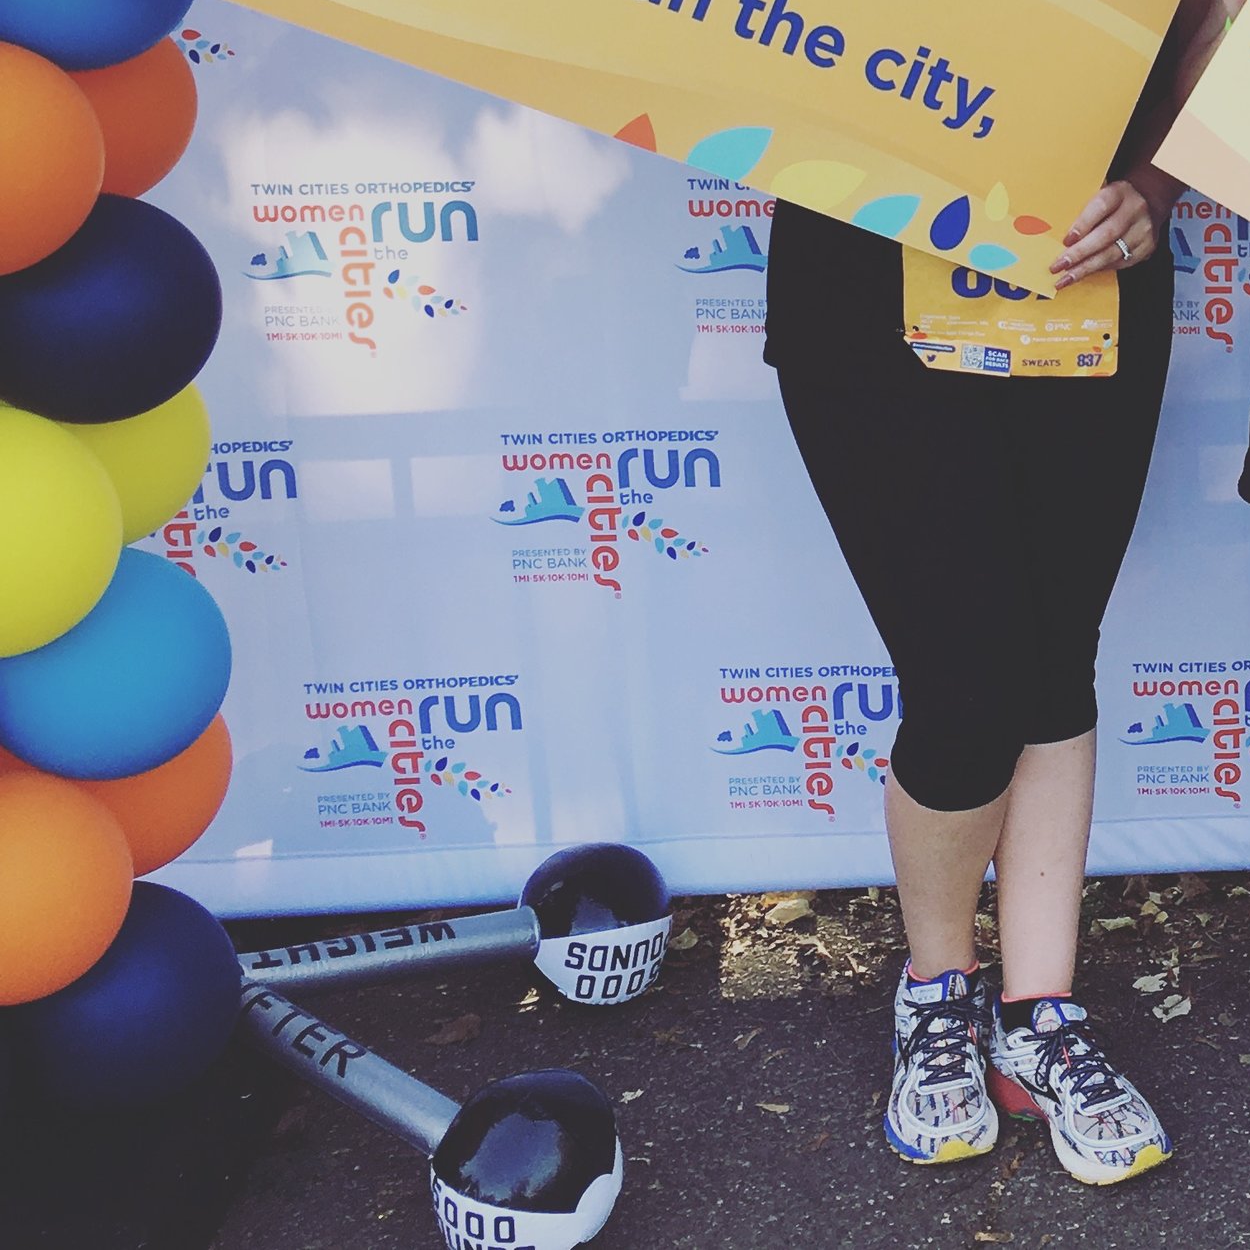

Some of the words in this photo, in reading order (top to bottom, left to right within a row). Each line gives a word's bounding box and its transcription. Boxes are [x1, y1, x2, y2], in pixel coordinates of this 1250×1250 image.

[866, 47, 993, 137] city,
[251, 203, 364, 223] women
[371, 200, 479, 243] run
[373, 246, 408, 261] the
[338, 225, 378, 349] cities
[1022, 359, 1061, 367] SWEATS
[1077, 354, 1102, 367] 837
[501, 451, 611, 471] women
[617, 447, 720, 488] run
[619, 489, 653, 504] the
[585, 474, 623, 591] cities
[302, 682, 344, 694] TWIN
[350, 680, 398, 692] CITIES
[717, 685, 828, 702] women
[1131, 679, 1238, 696] women
[304, 698, 413, 719] women
[419, 692, 522, 733] run
[835, 722, 867, 736] the
[422, 735, 455, 749] the
[1212, 698, 1247, 802] cities
[801, 706, 838, 812] cities
[387, 719, 426, 832] cities
[318, 793, 374, 802] PRESENTED
[377, 792, 390, 800] BY
[318, 804, 347, 815] PNC
[351, 801, 392, 814] BANK
